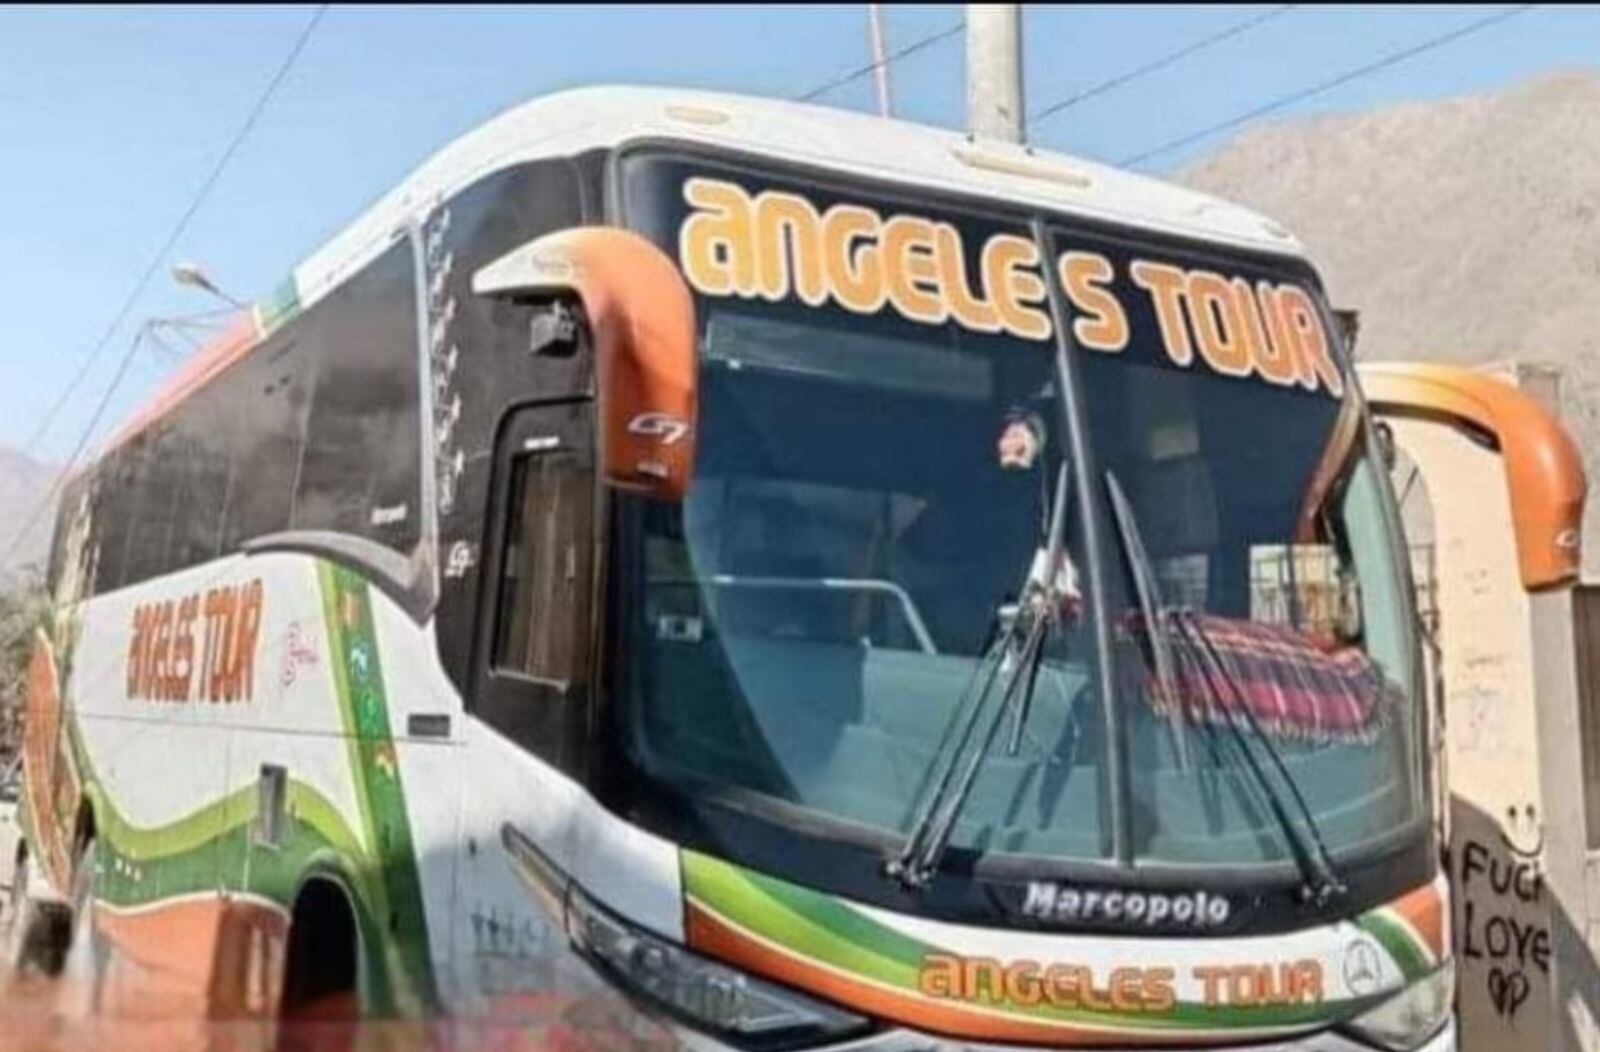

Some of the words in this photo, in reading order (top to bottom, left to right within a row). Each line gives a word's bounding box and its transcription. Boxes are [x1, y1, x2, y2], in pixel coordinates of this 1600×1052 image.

[1130, 259, 1343, 397] TOUR
[200, 577, 264, 703] TOUR
[1022, 881, 1230, 925] Marcopolo
[1191, 959, 1324, 1006] TOUR
